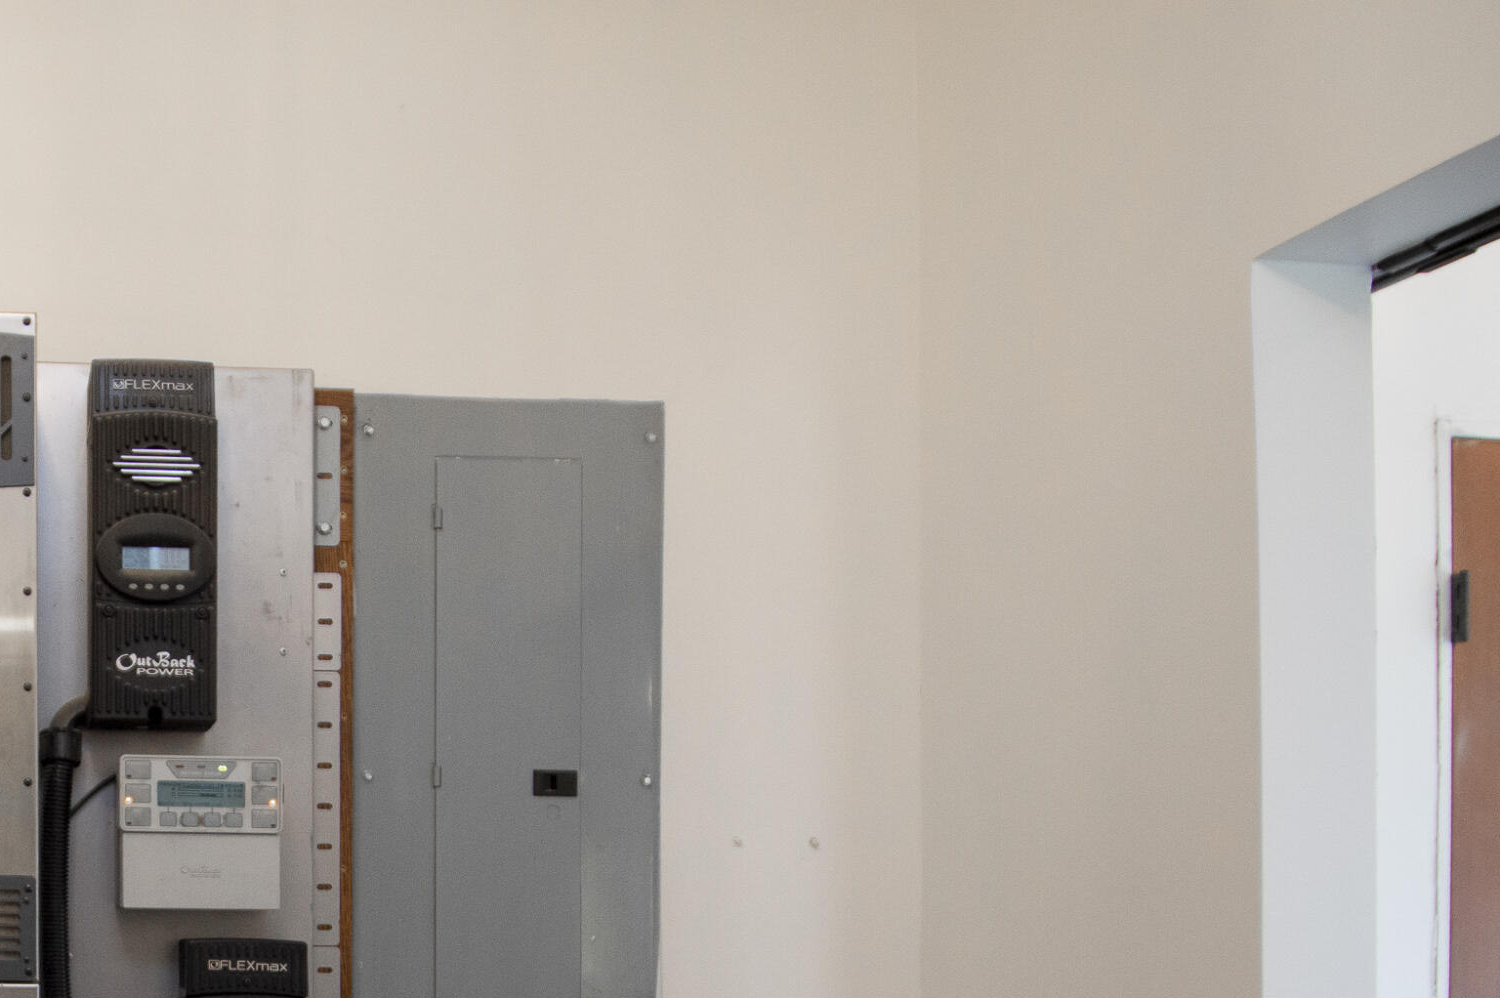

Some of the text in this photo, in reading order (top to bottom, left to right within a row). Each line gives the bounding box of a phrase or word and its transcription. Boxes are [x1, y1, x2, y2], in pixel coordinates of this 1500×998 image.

[124, 379, 194, 391] FLEXmax
[116, 651, 196, 671] OutBack
[136, 667, 194, 676] POWER
[220, 960, 288, 972] FLEXmax
